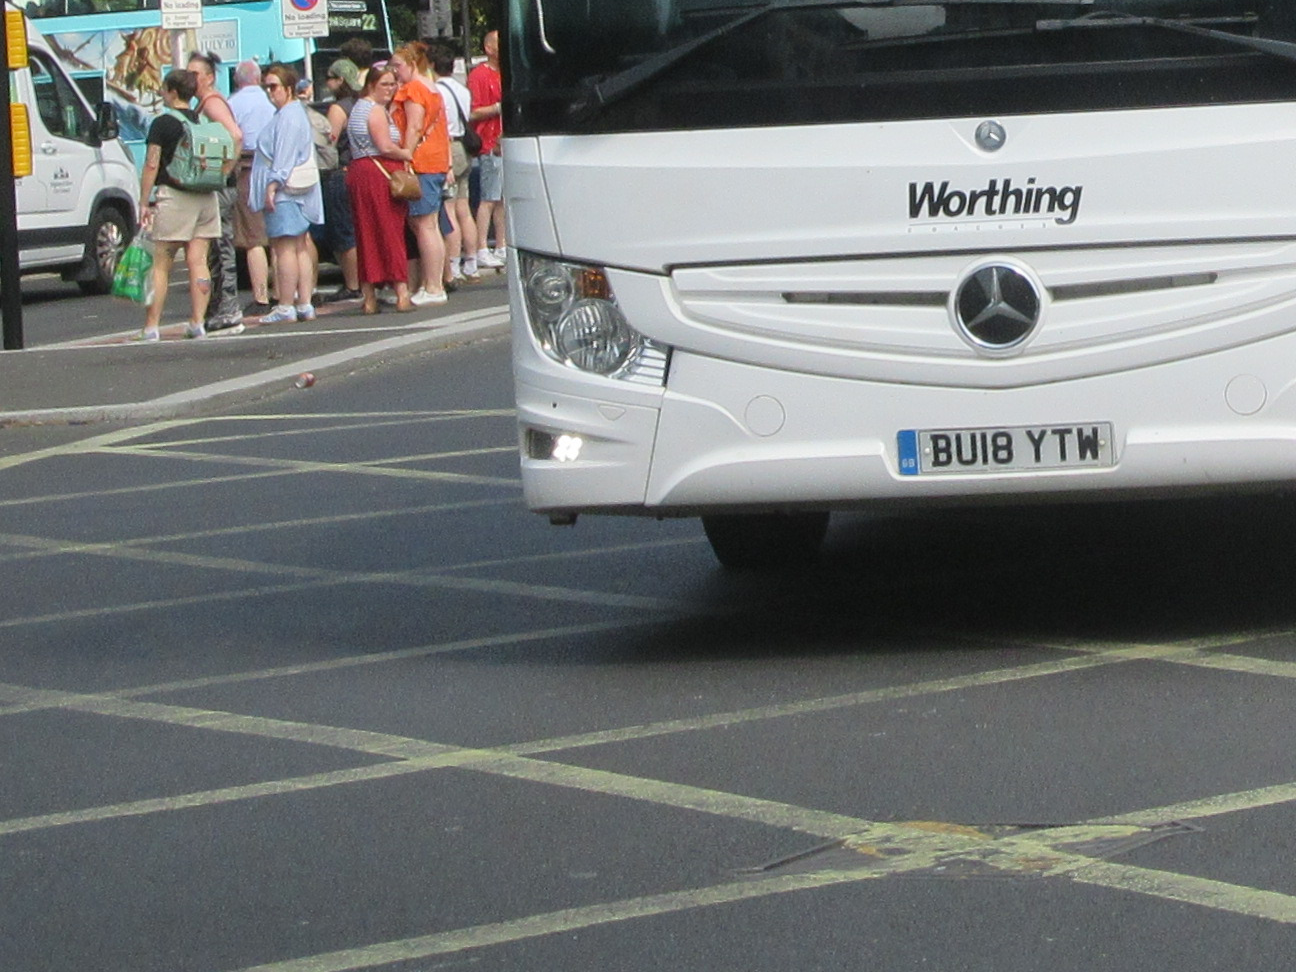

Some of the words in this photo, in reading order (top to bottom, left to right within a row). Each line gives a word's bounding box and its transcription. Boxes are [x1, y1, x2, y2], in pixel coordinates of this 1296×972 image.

[285, 13, 296, 21] No
[297, 12, 326, 20] loading
[362, 14, 377, 31] 22
[908, 177, 1083, 225] Worthing
[930, 431, 1014, 467] BU18
[1025, 426, 1099, 463] YTW
